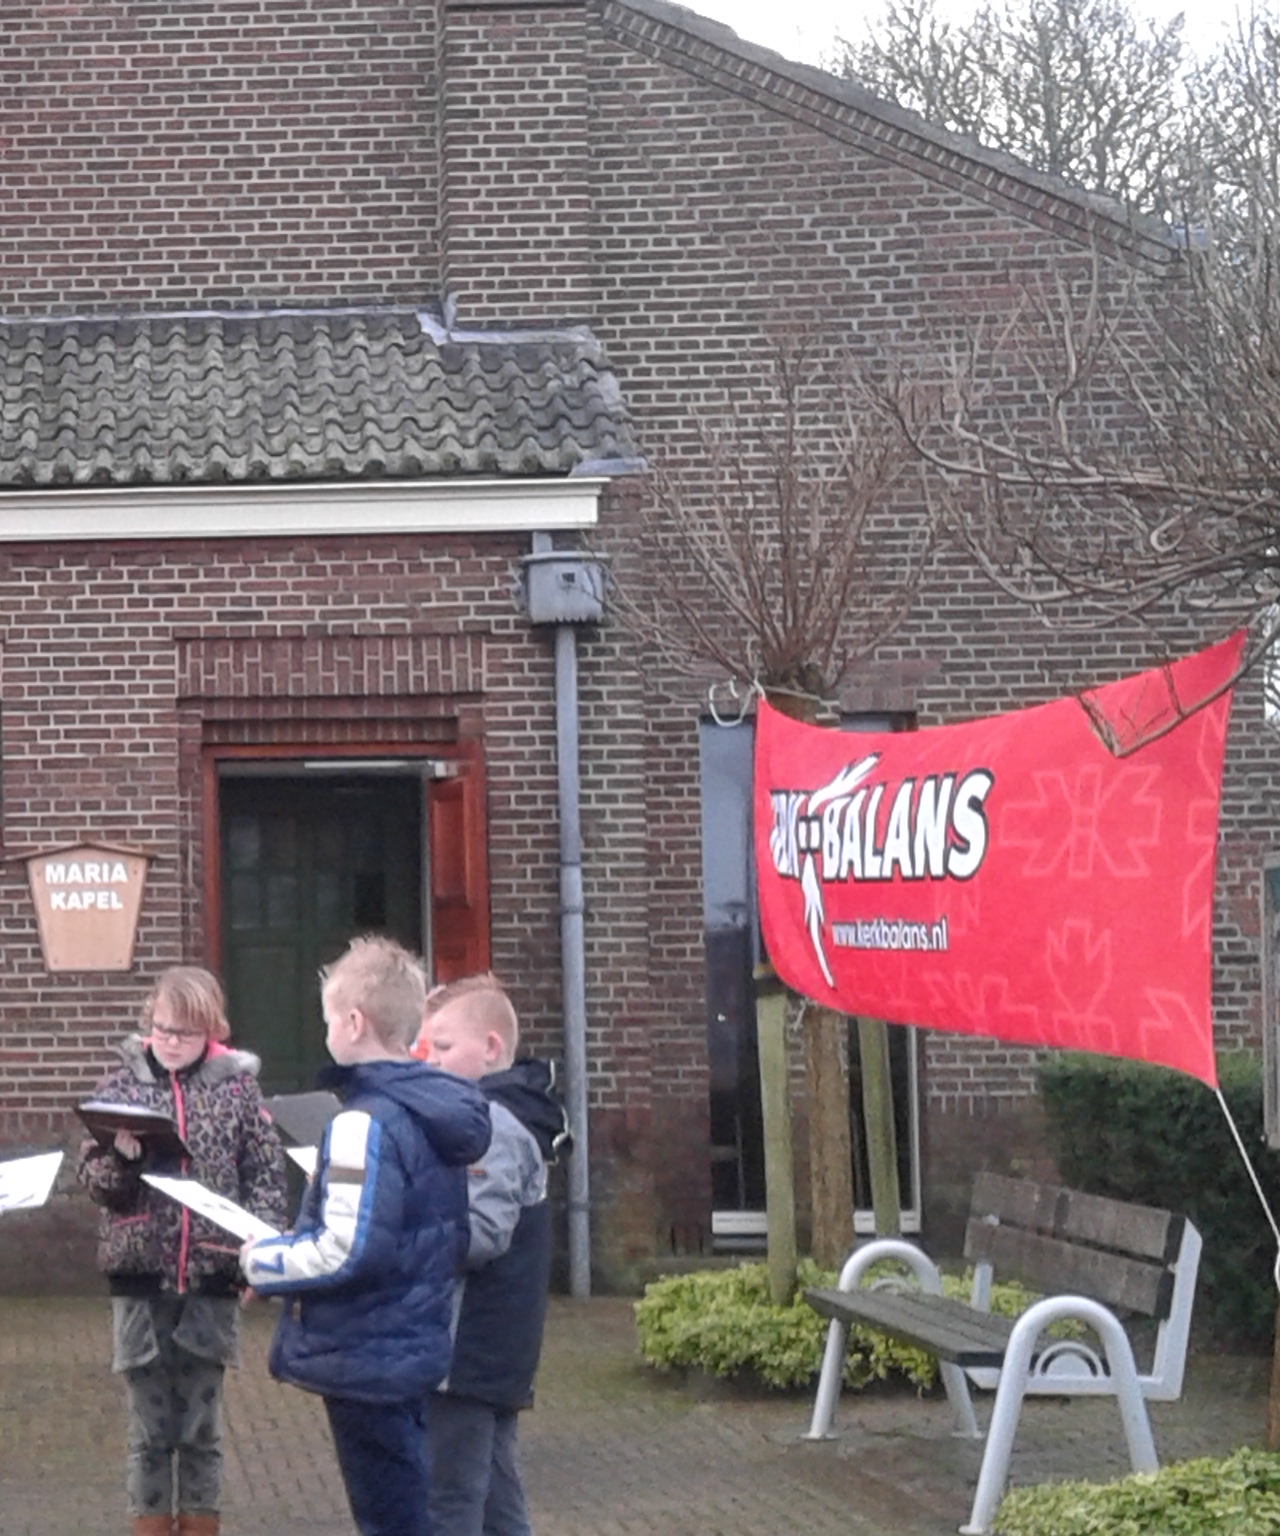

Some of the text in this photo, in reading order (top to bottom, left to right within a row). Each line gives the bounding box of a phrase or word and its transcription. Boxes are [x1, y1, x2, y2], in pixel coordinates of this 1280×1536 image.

[821, 768, 994, 882] BALANS
[45, 862, 128, 885] MARIA
[50, 890, 124, 911] KAPEL
[832, 916, 949, 951] www.kerkbalans.nl
